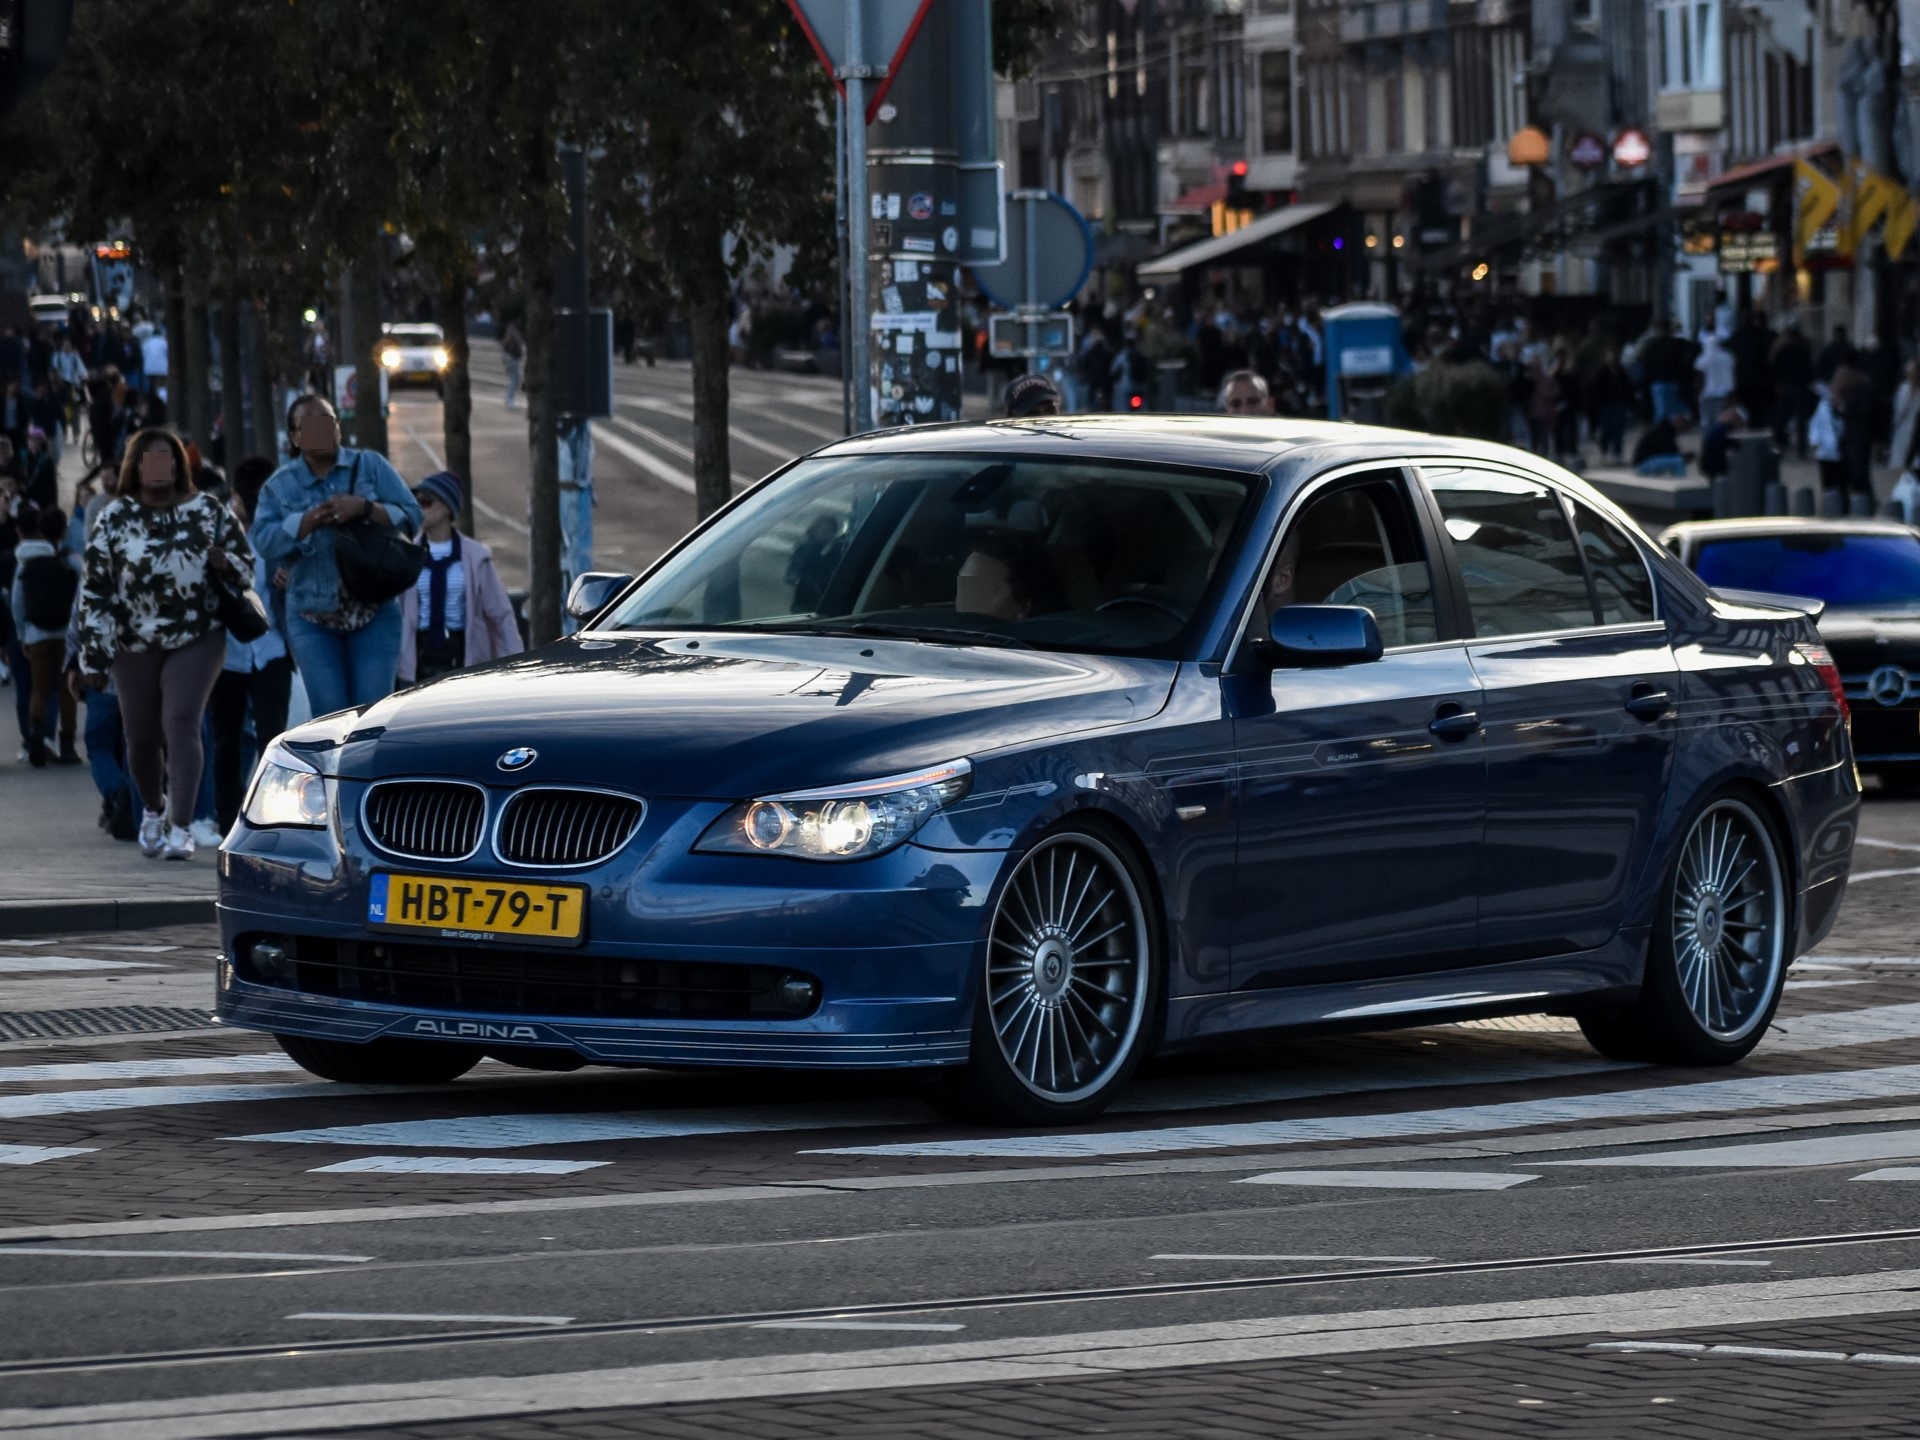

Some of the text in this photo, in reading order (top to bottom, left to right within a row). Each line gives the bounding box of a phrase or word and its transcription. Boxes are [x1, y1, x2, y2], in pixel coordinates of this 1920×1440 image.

[1326, 753, 1359, 762] ALPINA
[370, 903, 385, 916] NL
[401, 882, 568, 930] HBT-79-T
[459, 930, 482, 940] Garage
[414, 1020, 539, 1040] ALPINA
